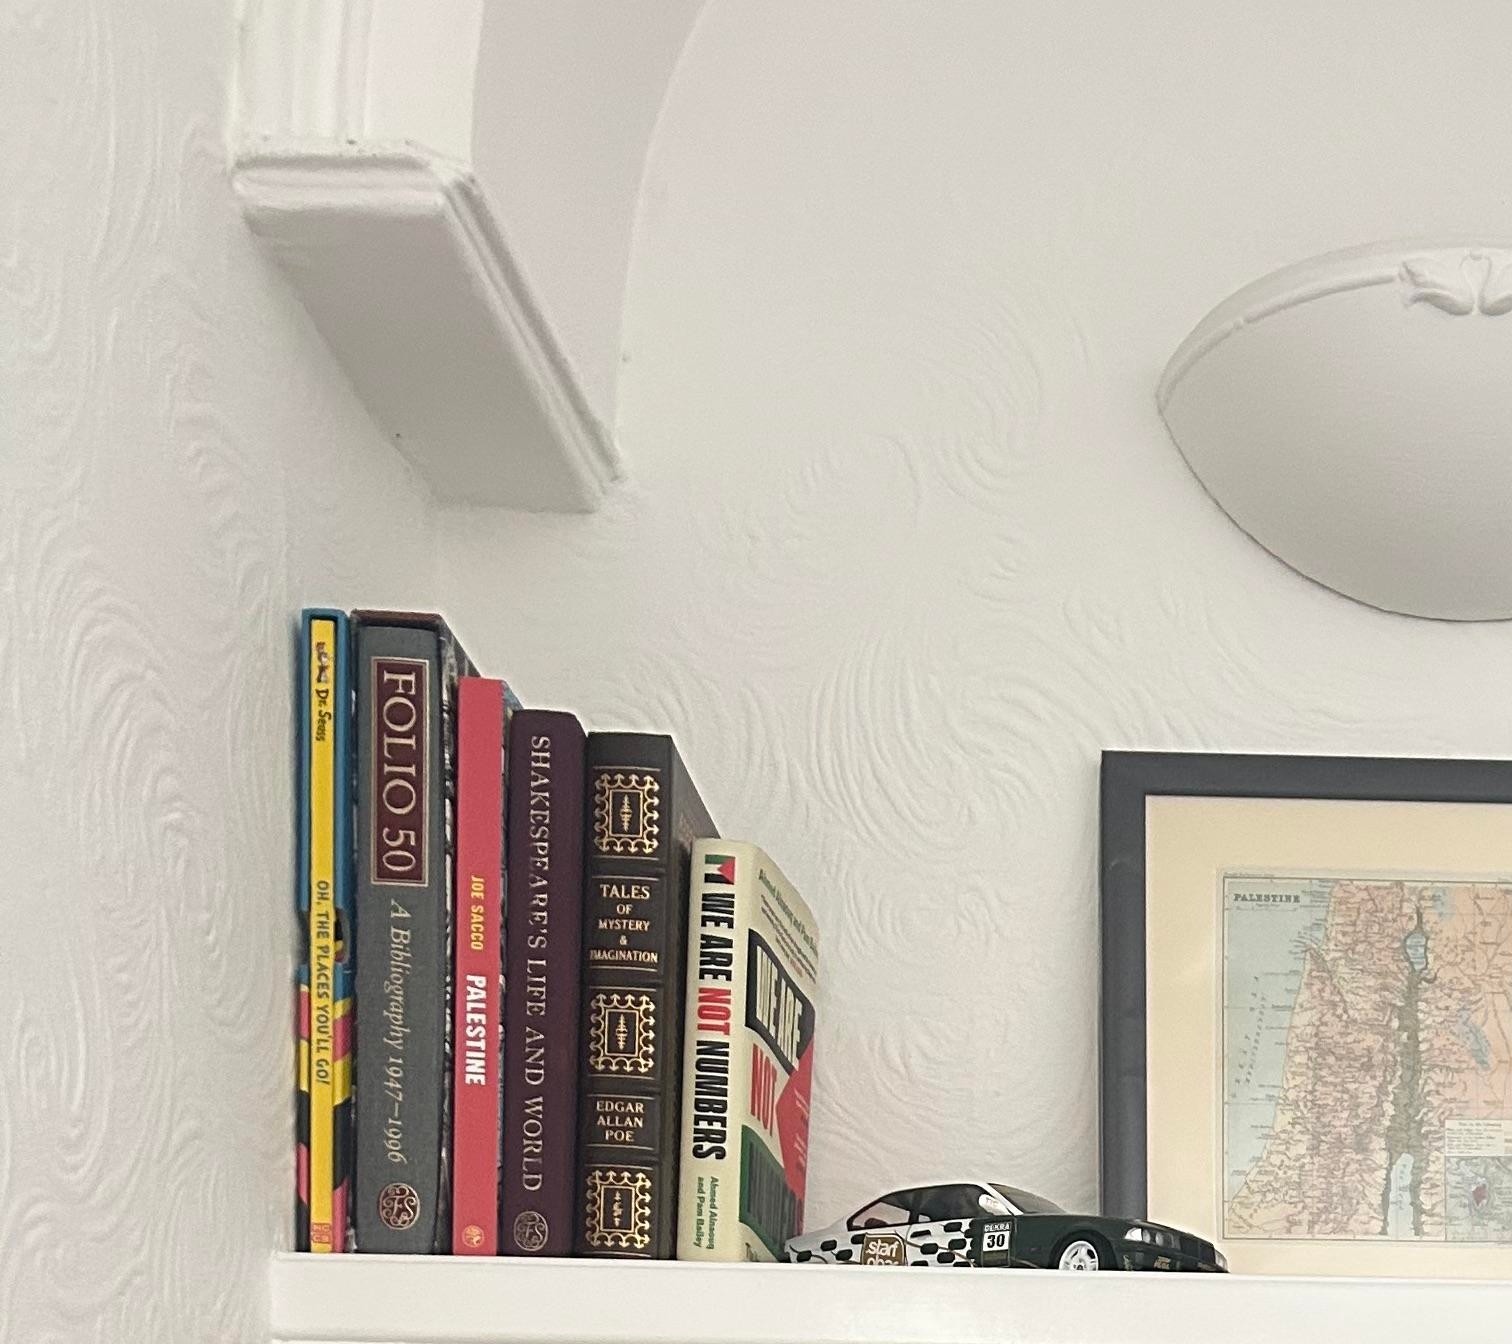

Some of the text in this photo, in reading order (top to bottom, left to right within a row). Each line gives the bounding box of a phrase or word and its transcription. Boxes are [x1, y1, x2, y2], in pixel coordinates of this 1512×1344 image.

[383, 671, 417, 872] FOLIO 50
[600, 885, 651, 899] TALES
[1233, 893, 1300, 902] PALESTINE
[316, 912, 329, 938] THE
[470, 876, 485, 950] JOE SACCO
[598, 919, 650, 931] MYSTERY
[523, 736, 549, 1192] SHAKESPEARE'S LIFE AND WORLD
[589, 949, 658, 963] IMAGINATION
[316, 945, 330, 1001] PLACES
[316, 1004, 331, 1051] YOU'LL
[465, 975, 487, 1085] PALESTINE
[692, 893, 734, 1160] WE ARE NOT NUMBERS
[315, 1059, 331, 1085] GO!
[596, 1102, 644, 1113] EDGAR
[597, 1116, 643, 1127] ALLAN
[605, 1130, 634, 1141] POE
[987, 1233, 1005, 1250] 30
